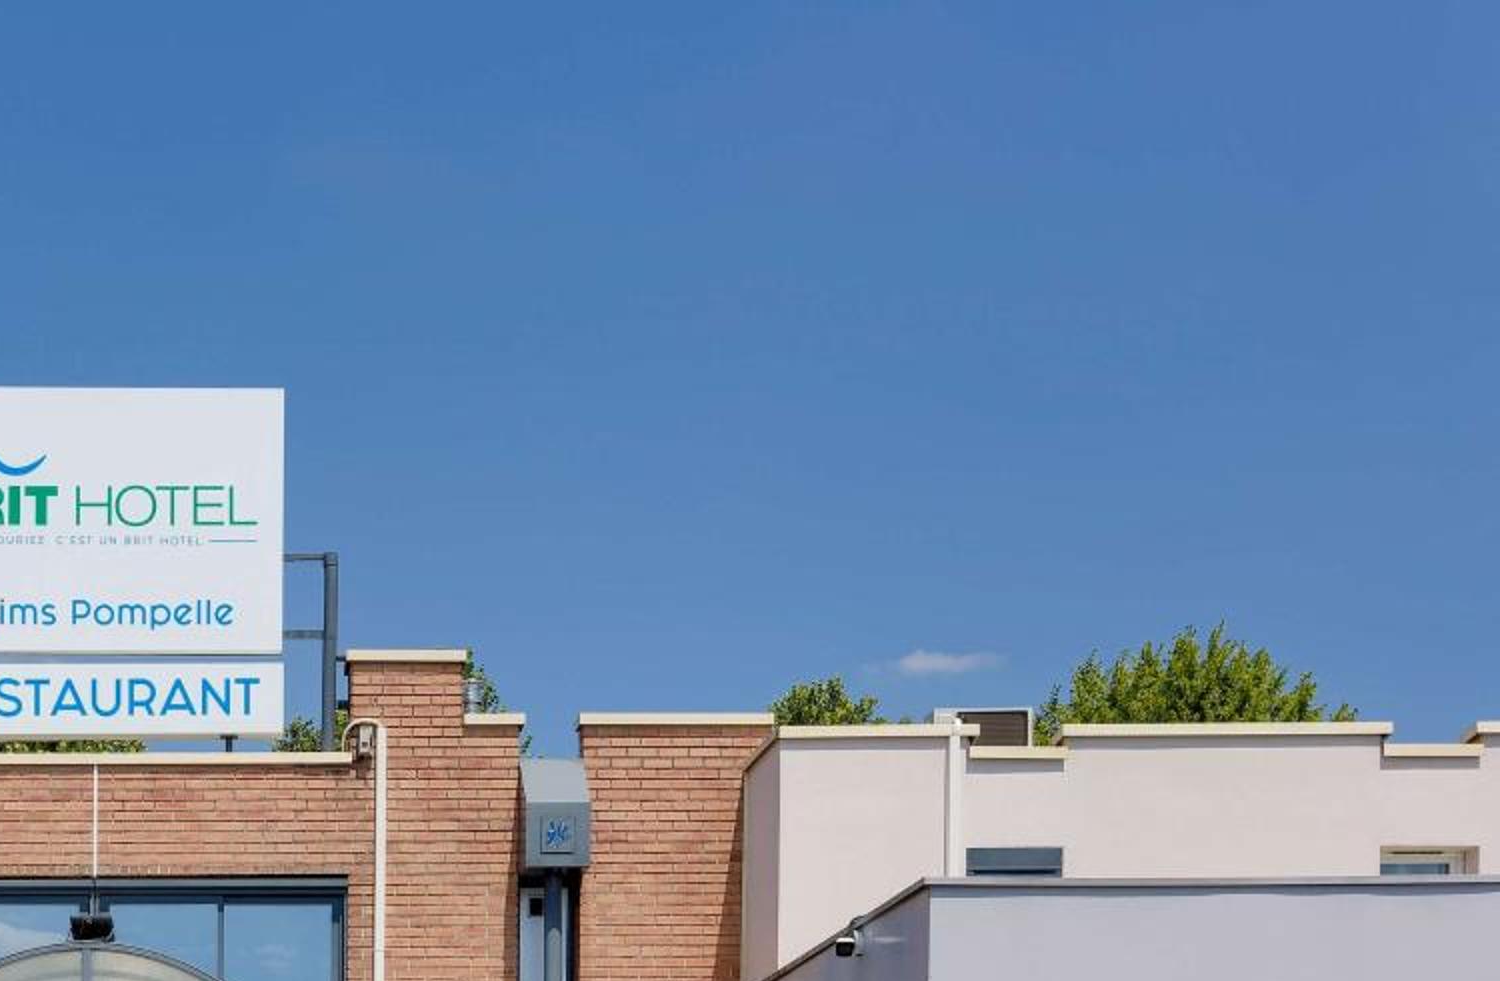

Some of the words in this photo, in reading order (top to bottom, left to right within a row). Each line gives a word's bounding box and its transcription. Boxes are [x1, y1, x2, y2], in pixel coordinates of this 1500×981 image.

[75, 485, 259, 526] HOTEL
[99, 536, 117, 545] UN
[123, 535, 155, 545] BRIT
[71, 598, 234, 631] Pompelle
